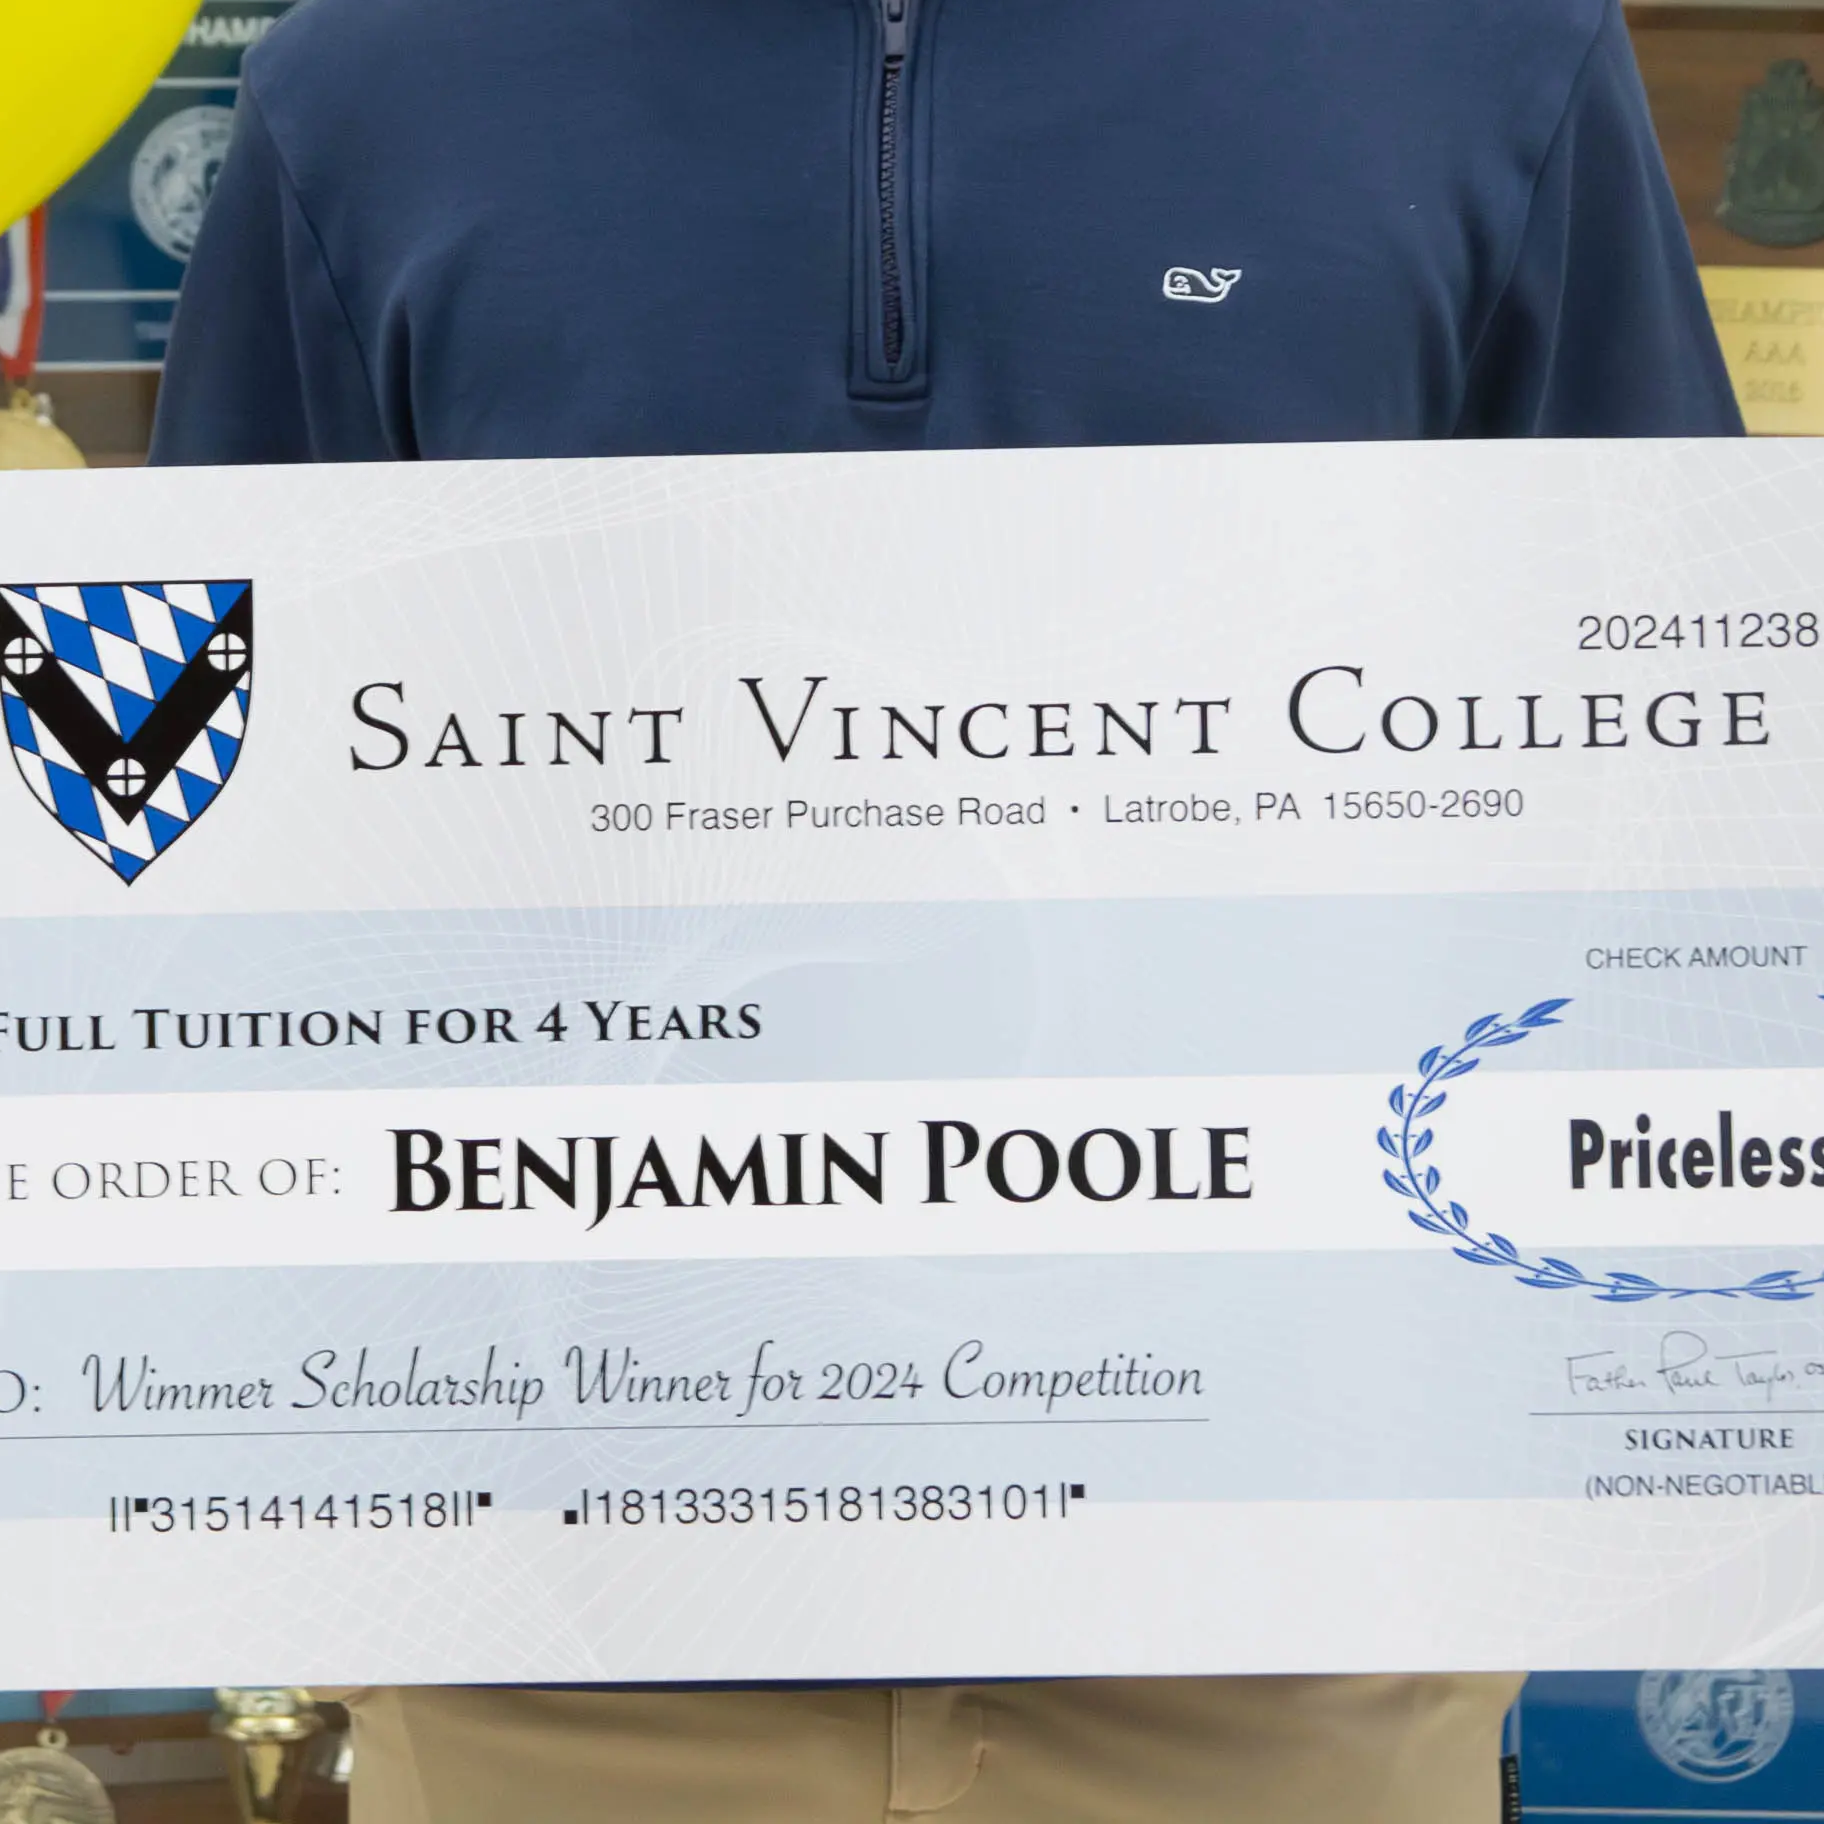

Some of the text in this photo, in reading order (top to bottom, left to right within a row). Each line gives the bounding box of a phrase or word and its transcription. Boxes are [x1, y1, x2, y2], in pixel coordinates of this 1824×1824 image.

[1578, 611, 1819, 651] 202411238
[591, 788, 1524, 833] 300 Fraser Purchase Road Latrobe, PA 15650-2690
[1585, 945, 1808, 970] CHECK AMOUNT
[535, 1001, 568, 1042] 4
[52, 1160, 241, 1200] ORDER
[259, 1158, 340, 1196] OF:
[385, 1128, 890, 1232] BENJAMIN
[918, 1120, 1252, 1204] POOLE
[82, 1353, 273, 1413] Wimmer
[290, 1344, 544, 1421] Scholarship
[564, 1345, 730, 1405] Winner
[735, 1339, 803, 1418] for
[817, 1362, 924, 1400] 2024
[943, 1339, 1202, 1413] Competition
[1625, 1428, 1793, 1451] SIGNATURE
